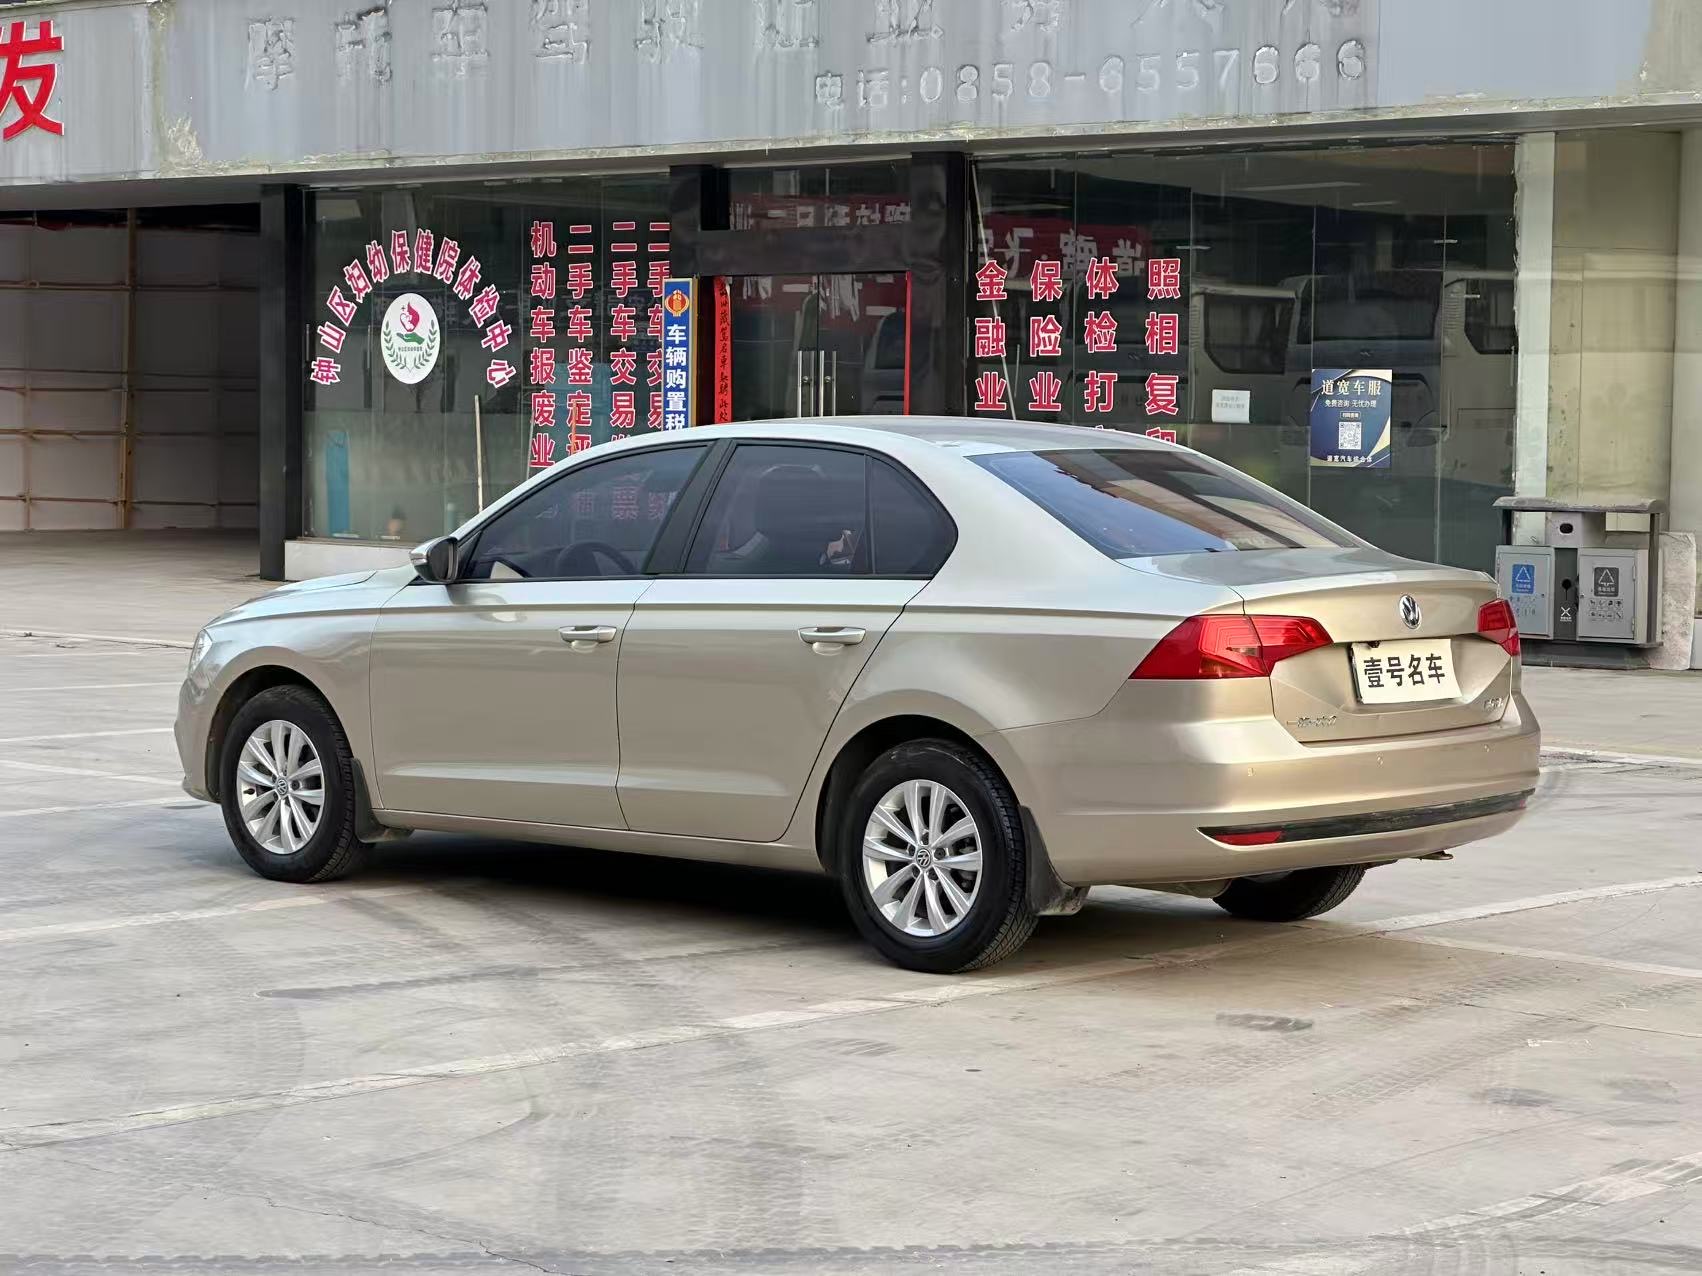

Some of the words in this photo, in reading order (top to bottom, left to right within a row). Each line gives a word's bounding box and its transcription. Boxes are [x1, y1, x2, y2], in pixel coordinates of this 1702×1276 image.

[0, 19, 65, 142] 发
[310, 227, 517, 390] 钟山区妇幼保健院体检中心
[530, 220, 557, 468] 机动车报废业
[609, 221, 637, 442] 二手车交易
[665, 323, 687, 432] 车辆购置税
[974, 258, 1008, 413] 金融业
[1028, 258, 1063, 413] 保险业
[1083, 256, 1118, 430] 体检打
[1321, 379, 1382, 396] 道宽车服
[1325, 399, 1350, 408] 免费咨询
[1363, 652, 1446, 689] 壹号名车
